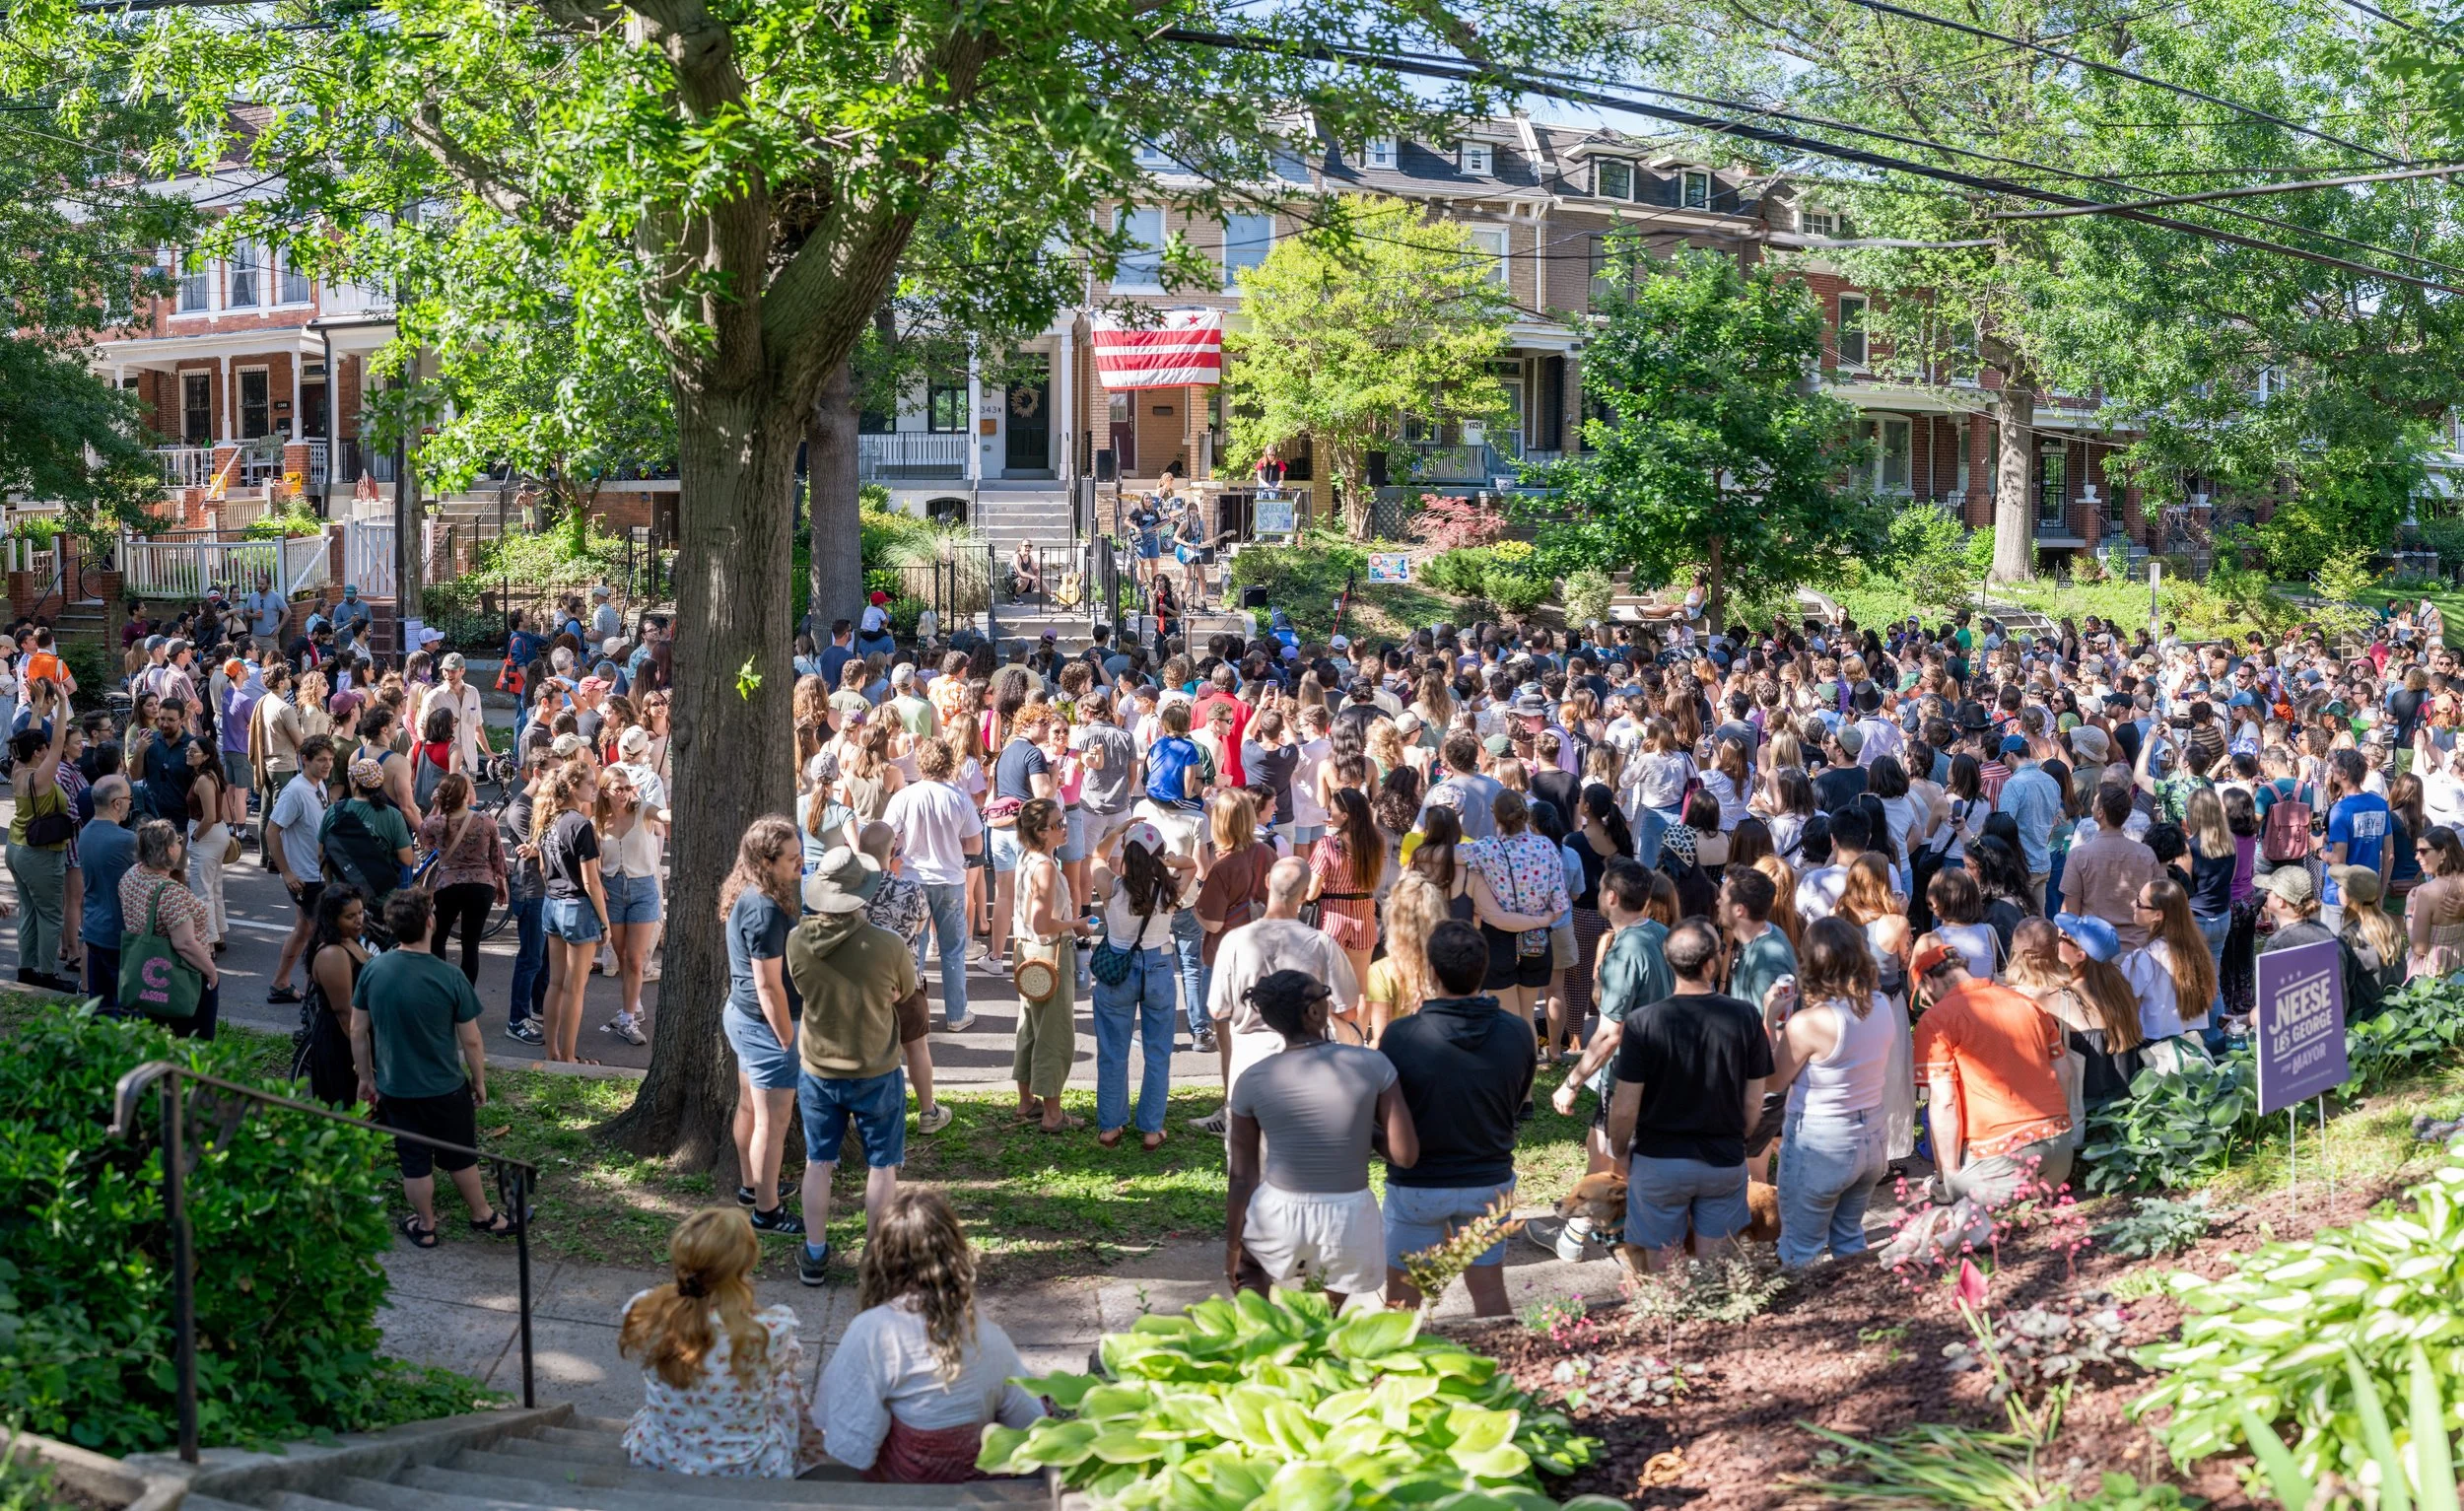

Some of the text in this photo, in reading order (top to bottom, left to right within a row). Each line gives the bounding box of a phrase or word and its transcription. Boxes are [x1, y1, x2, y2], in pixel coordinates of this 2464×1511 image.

[142, 957, 173, 988] C
[2292, 1008, 2333, 1043] GEORGE
[2293, 1042, 2327, 1075] MAYOR
